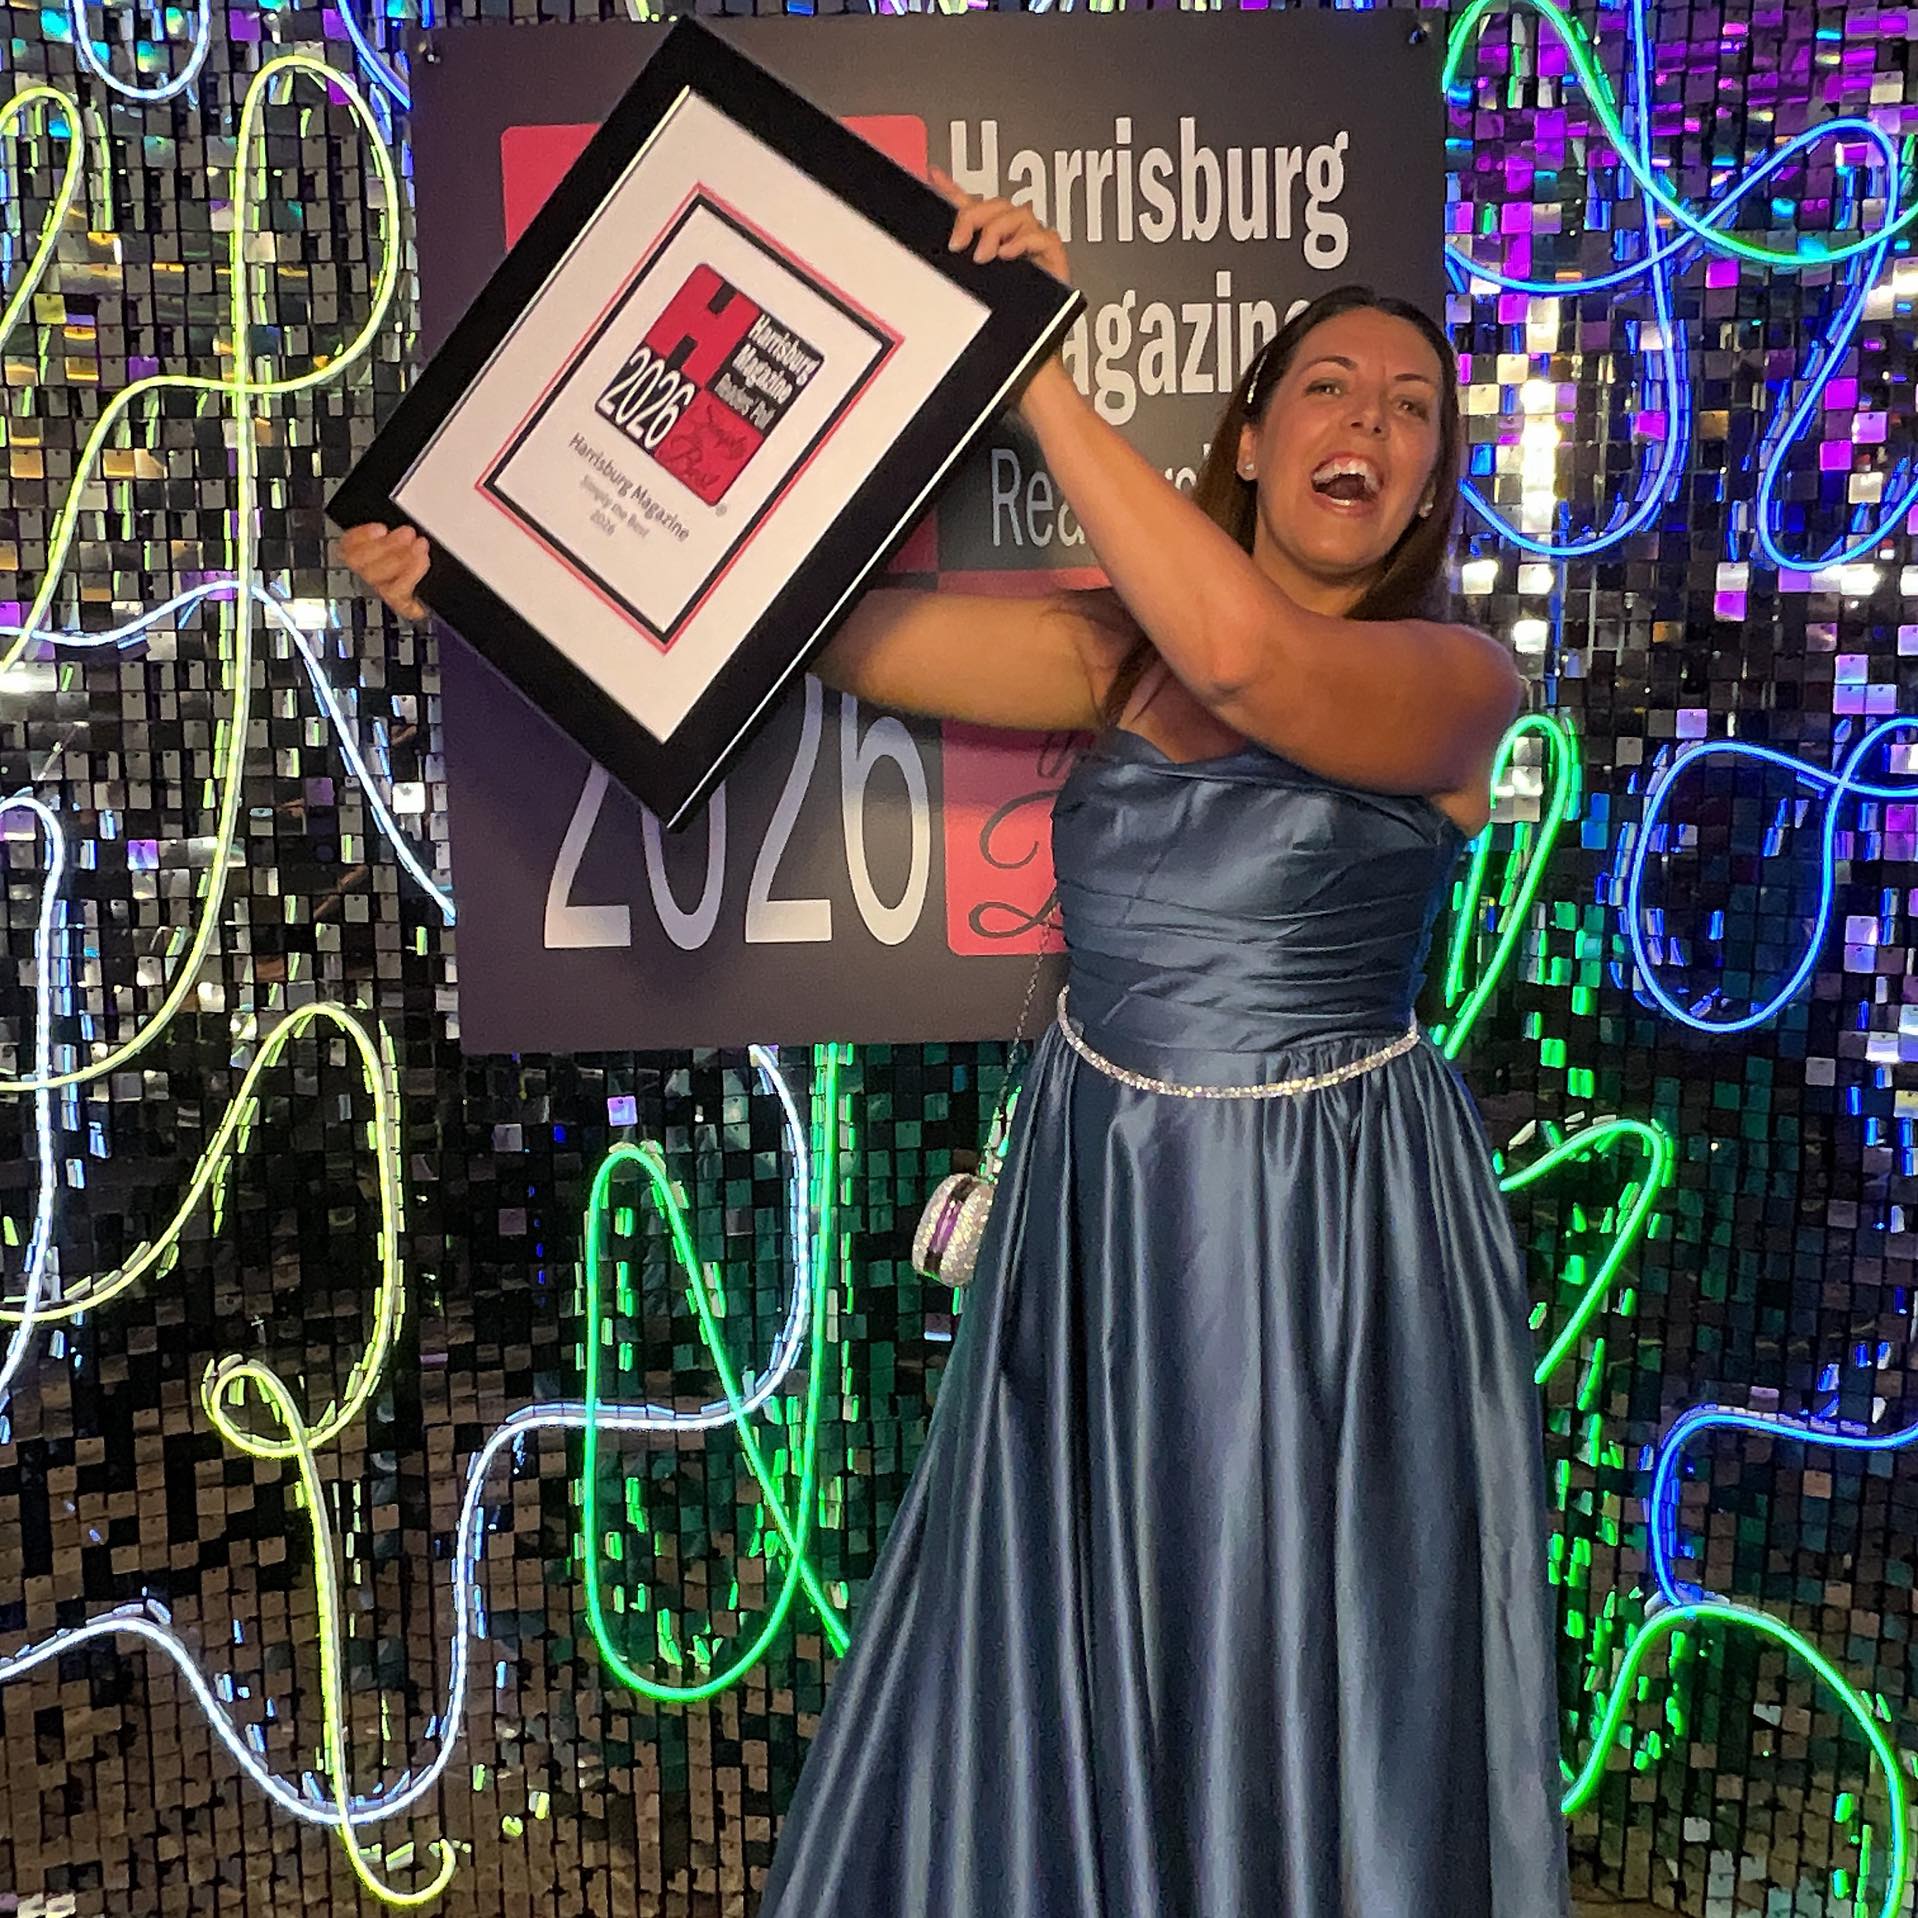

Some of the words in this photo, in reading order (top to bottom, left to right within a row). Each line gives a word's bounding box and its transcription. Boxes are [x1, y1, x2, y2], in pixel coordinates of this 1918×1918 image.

[949, 116, 1350, 270] Harrisburg
[599, 347, 693, 450] 2026
[732, 343, 793, 405] Magazine
[748, 313, 821, 387] Harrisburg
[1062, 270, 1311, 426] agazin
[568, 431, 634, 498] Harrisburg
[630, 484, 690, 542] Magazine
